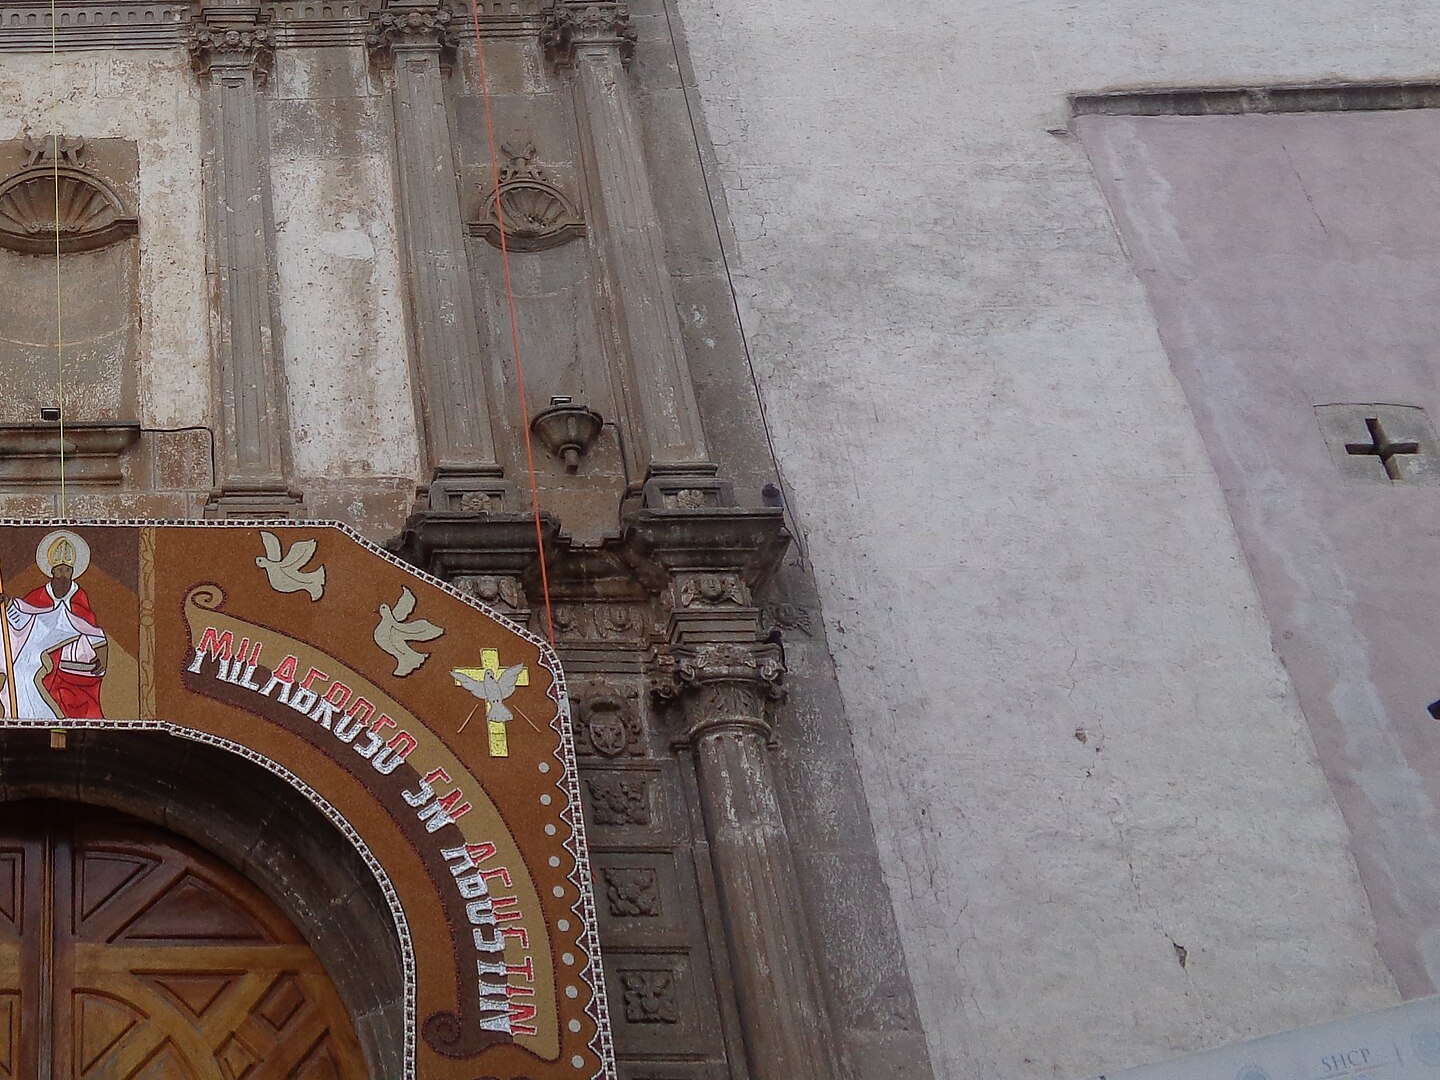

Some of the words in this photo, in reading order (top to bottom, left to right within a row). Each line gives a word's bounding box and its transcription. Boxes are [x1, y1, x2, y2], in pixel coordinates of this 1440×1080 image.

[187, 627, 418, 775] MILAGROSO
[401, 767, 472, 833] SN
[440, 841, 537, 1035] AGUSTIN
[1321, 1048, 1370, 1071] SHCP
